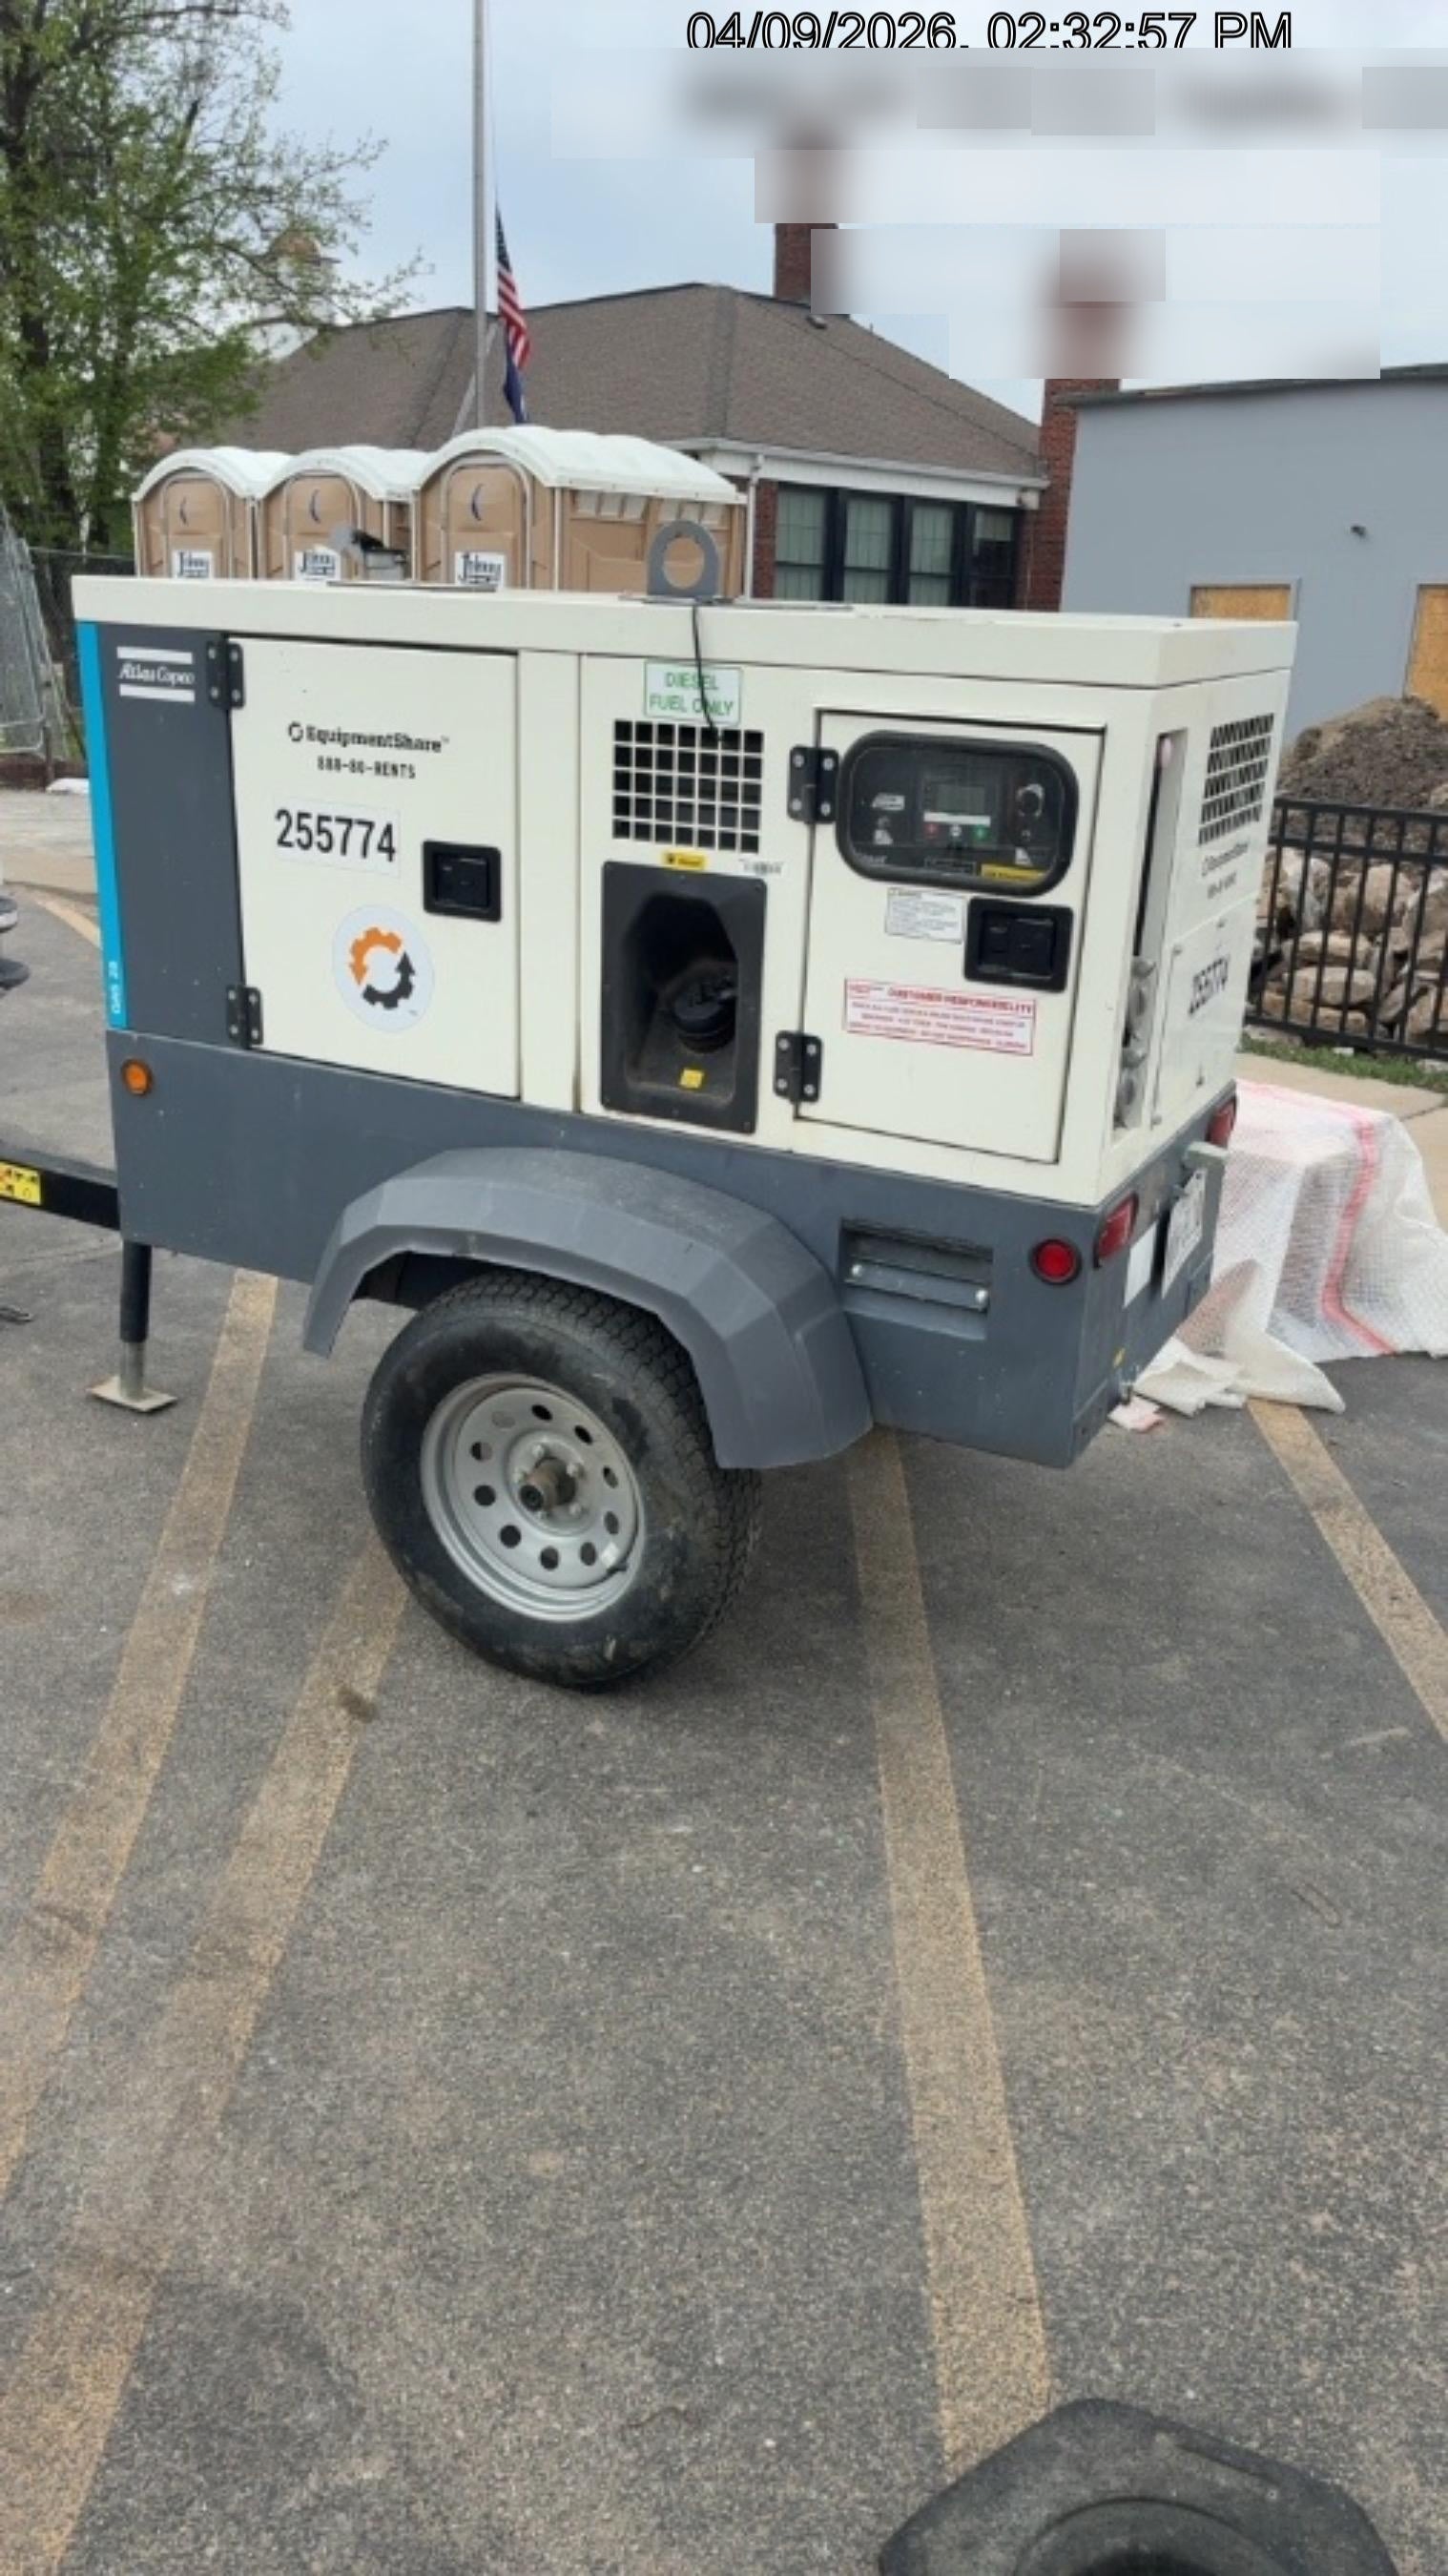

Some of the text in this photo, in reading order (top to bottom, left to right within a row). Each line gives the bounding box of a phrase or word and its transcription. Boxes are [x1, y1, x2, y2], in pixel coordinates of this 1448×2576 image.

[118, 662, 196, 687] Atlas Copco
[649, 694, 687, 713] FUEL
[317, 755, 416, 779] 888-80-RENTS
[275, 808, 397, 863] 255774
